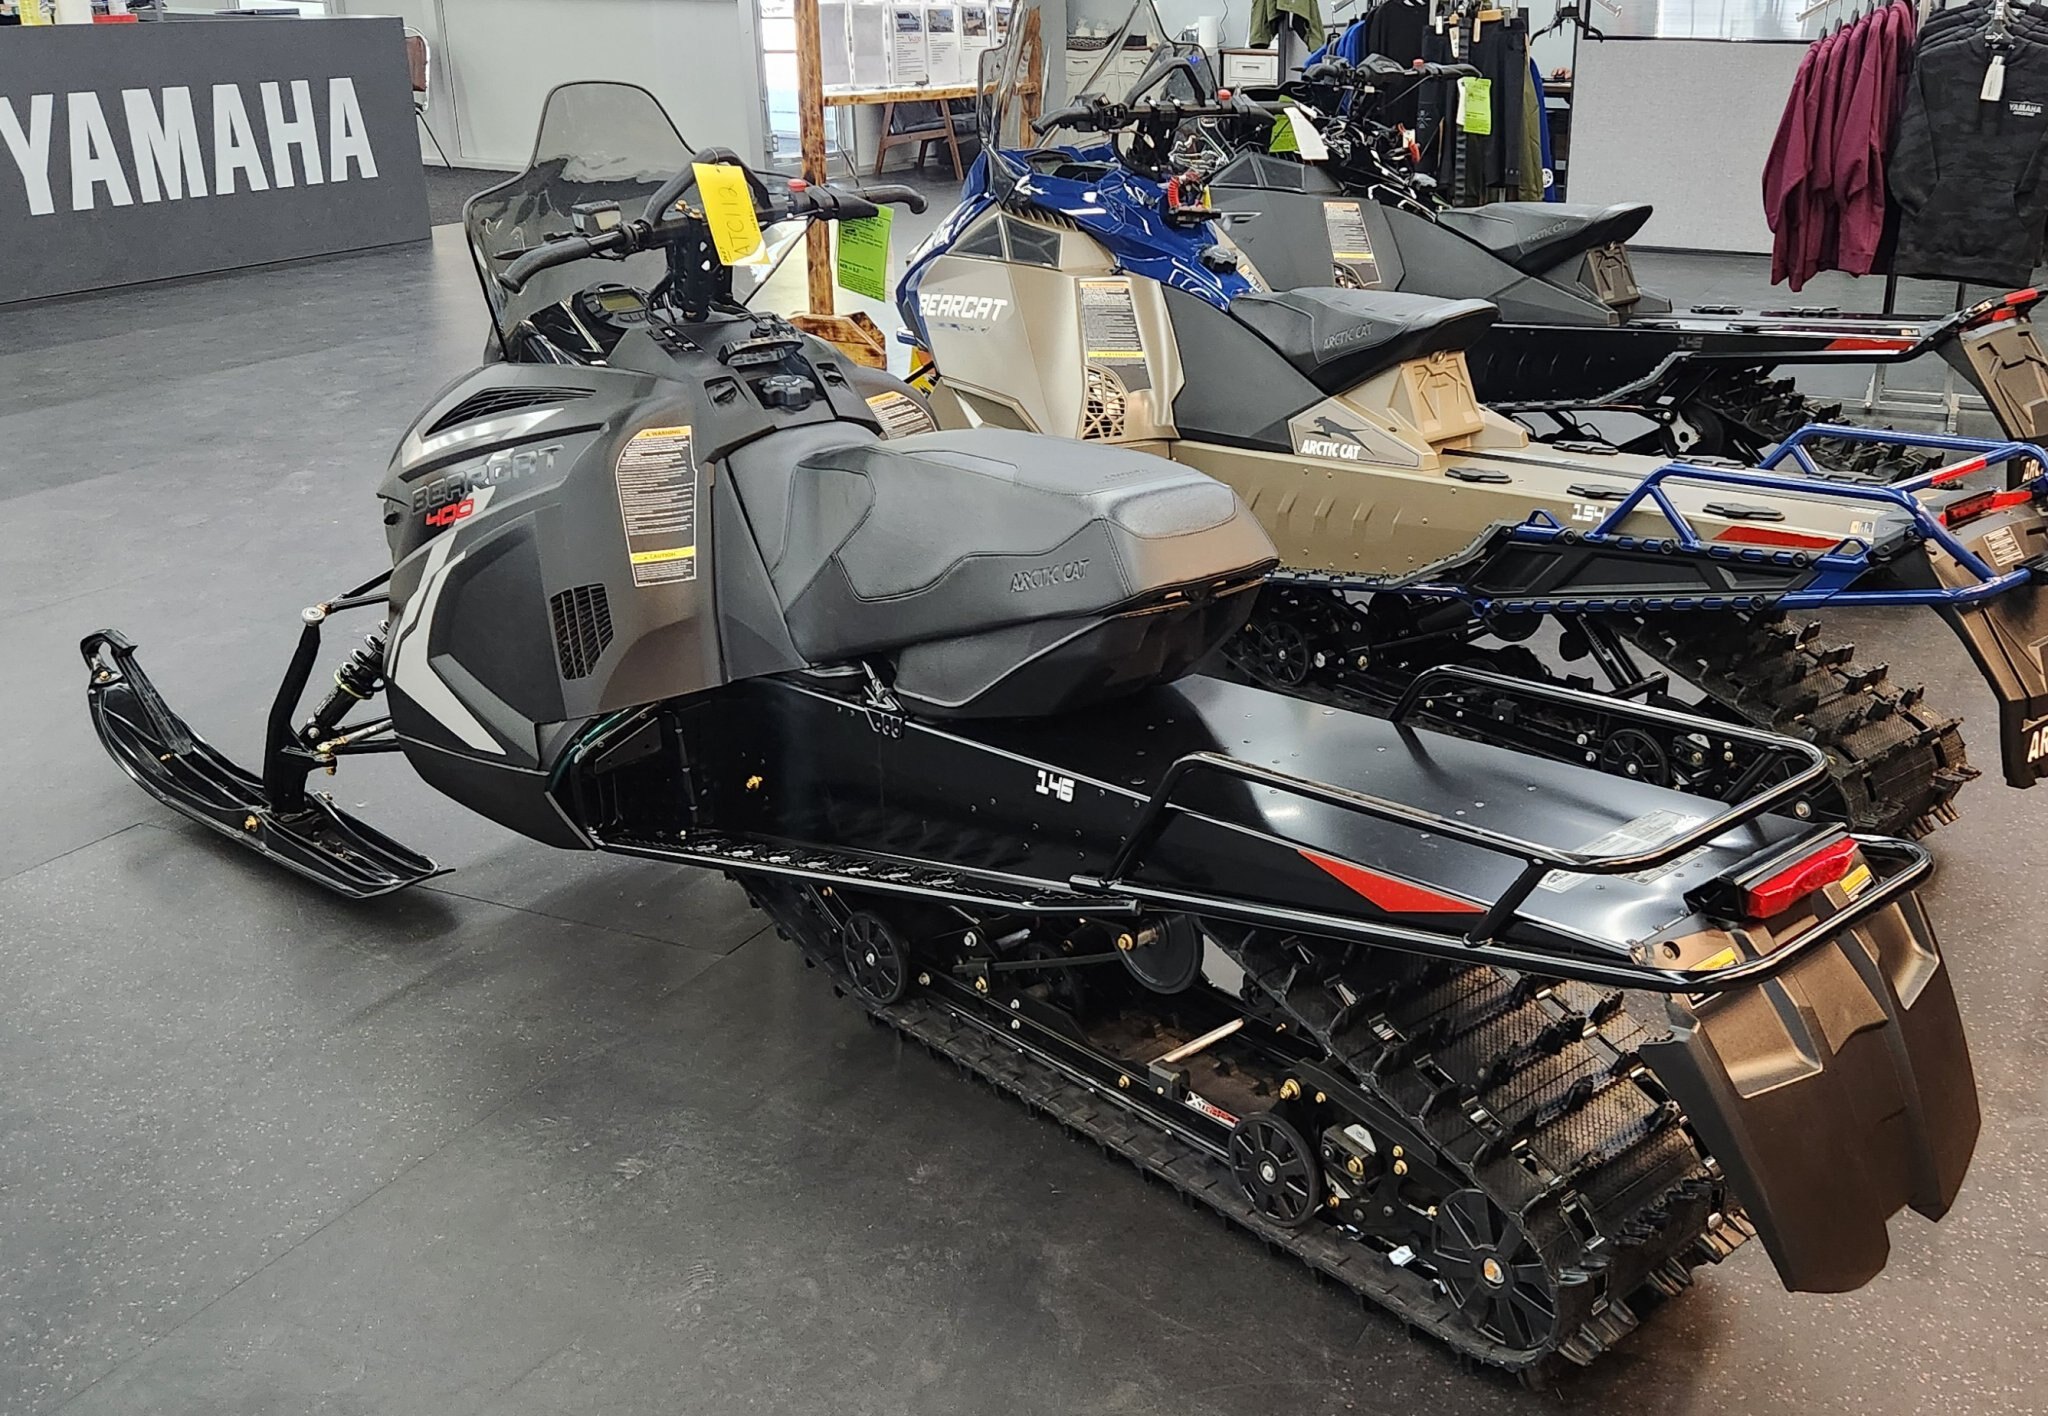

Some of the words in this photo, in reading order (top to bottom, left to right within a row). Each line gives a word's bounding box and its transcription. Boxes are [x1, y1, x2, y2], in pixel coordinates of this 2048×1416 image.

[2009, 103, 2042, 113] YAMAHA
[0, 77, 379, 215] YAMAHA
[919, 293, 1008, 322] BEARCAT
[1322, 328, 1354, 351] ARCTIC
[1355, 321, 1373, 339] CAT
[1300, 439, 1340, 458] ARCTIC
[1339, 443, 1362, 460] CAT
[412, 444, 565, 515] BEARCAT
[426, 497, 475, 526] 400
[1571, 503, 1606, 524] 154
[1010, 564, 1060, 593] ARCTIC
[1062, 558, 1090, 582] CAT
[1035, 769, 1075, 803] 146
